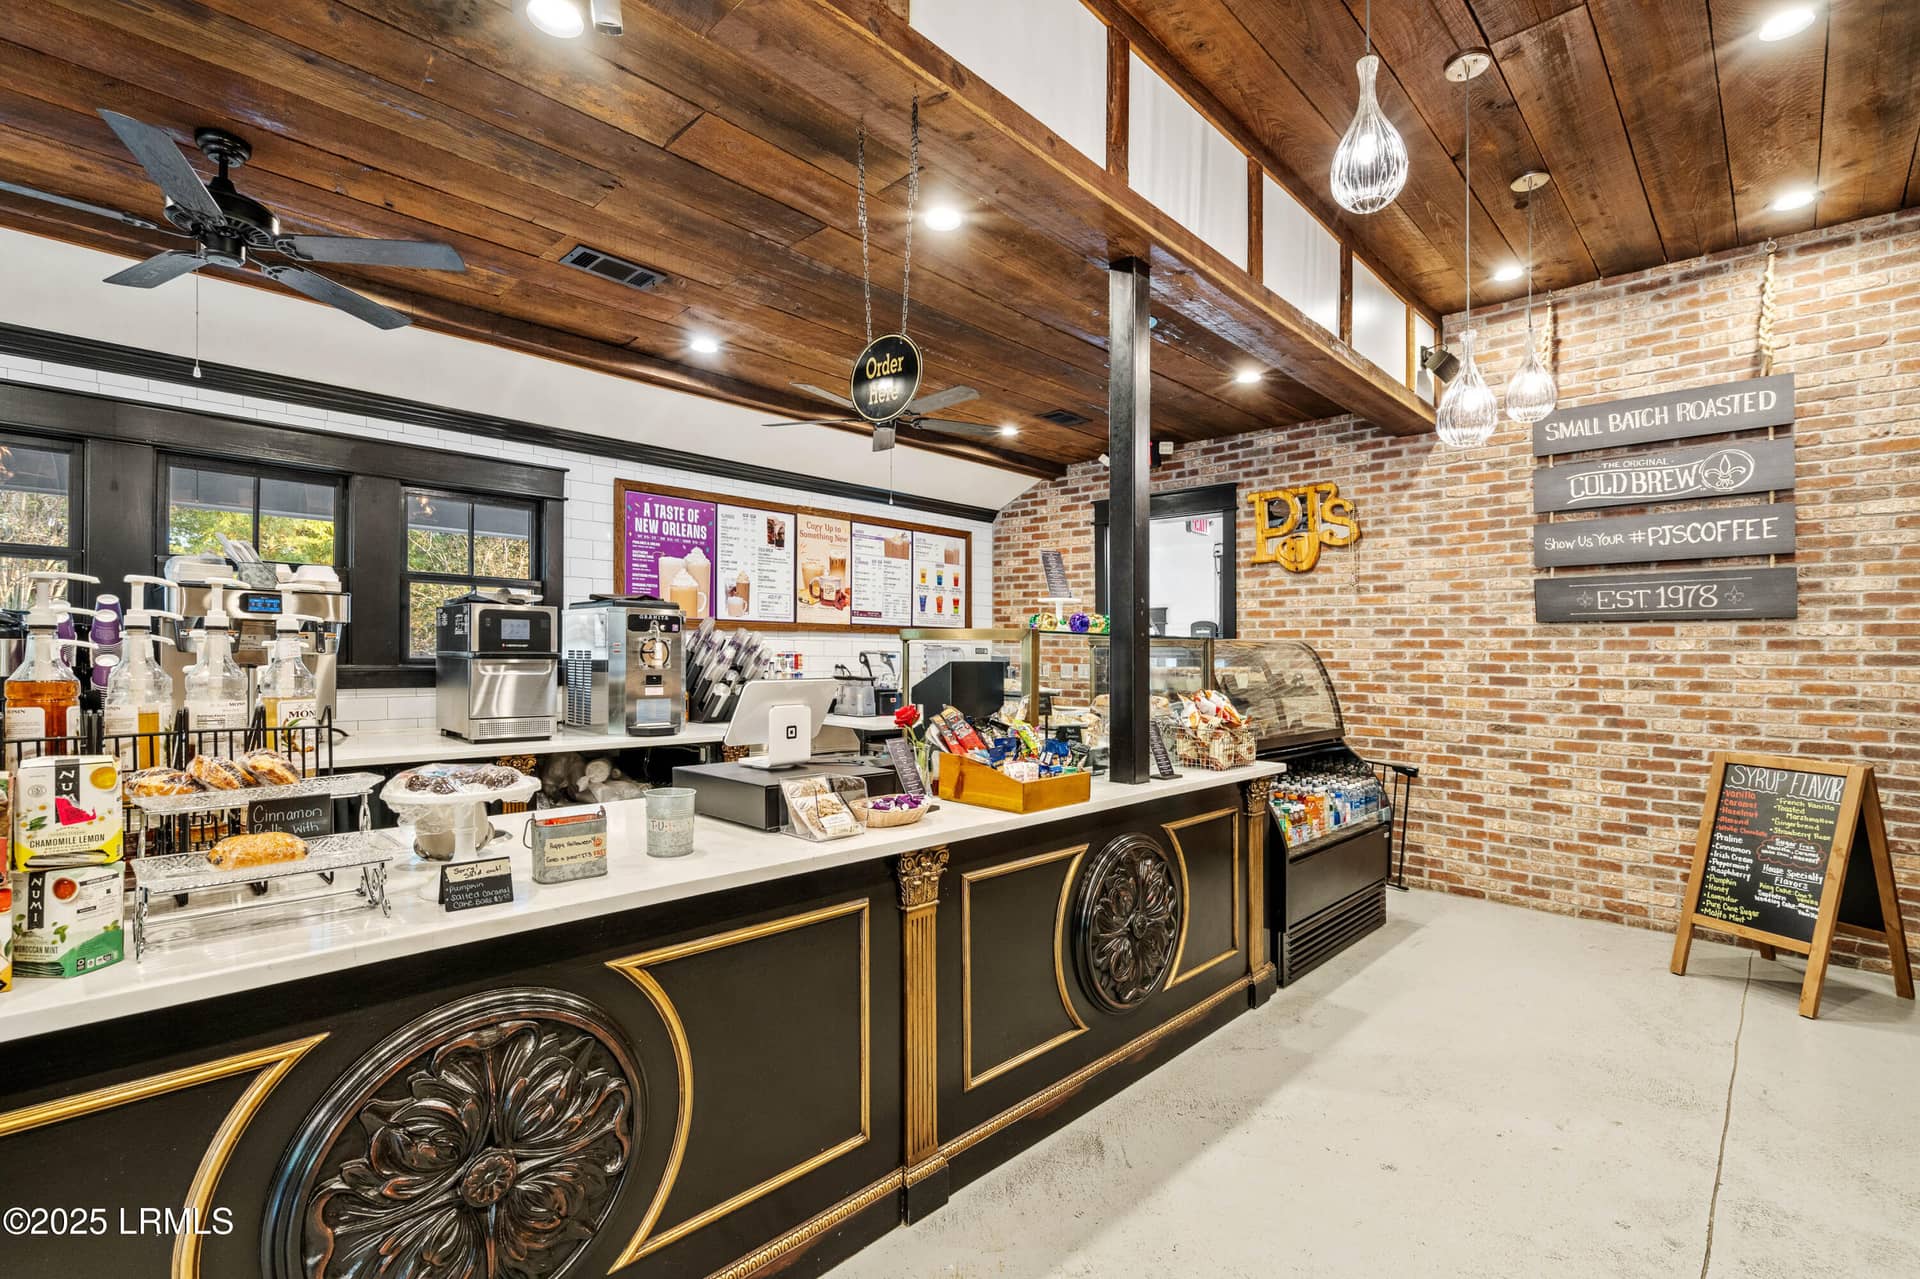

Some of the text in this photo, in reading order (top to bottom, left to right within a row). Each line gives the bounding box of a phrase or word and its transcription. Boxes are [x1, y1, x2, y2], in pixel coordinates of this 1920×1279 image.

[866, 353, 904, 380] Order
[868, 382, 898, 405] Here
[1545, 390, 1776, 441] SMALL BATCH ROASTED
[1602, 458, 1669, 469] THE ORIGINAL
[1570, 464, 1702, 499] COLD BREW
[644, 502, 650, 518] A
[654, 504, 685, 522] TASTE
[688, 508, 700, 524] OF
[634, 518, 659, 534] NEW
[662, 520, 708, 540] ORLEANS
[800, 530, 849, 543] Something New
[1544, 538, 1576, 551] Show
[1578, 536, 1594, 548] Us
[1595, 533, 1625, 546] YOUR
[1656, 584, 1718, 609] 1978
[1730, 765, 1845, 802] SYRUP FLAVOR
[1725, 790, 1756, 800] Vanilla
[1724, 799, 1758, 808] Caramel
[1776, 804, 1806, 814] Toasted
[1780, 798, 1835, 812] French Vanilla
[253, 804, 322, 824] Cinnamon
[1722, 806, 1758, 818] Hazelnut
[292, 822, 320, 834] with
[1720, 816, 1750, 826] Almond
[29, 834, 105, 848] CHAMOMILE LEMON
[1716, 832, 1744, 844] Praline
[1716, 842, 1752, 855] Cinnamon
[1714, 850, 1754, 864] Irish Cream
[1712, 858, 1750, 872] Peppermint
[1774, 876, 1808, 890] Flavors
[1786, 869, 1824, 885] Specialty
[1708, 883, 1730, 895] Honey
[1728, 914, 1746, 924] Mint
[44, 945, 58, 954] MINT
